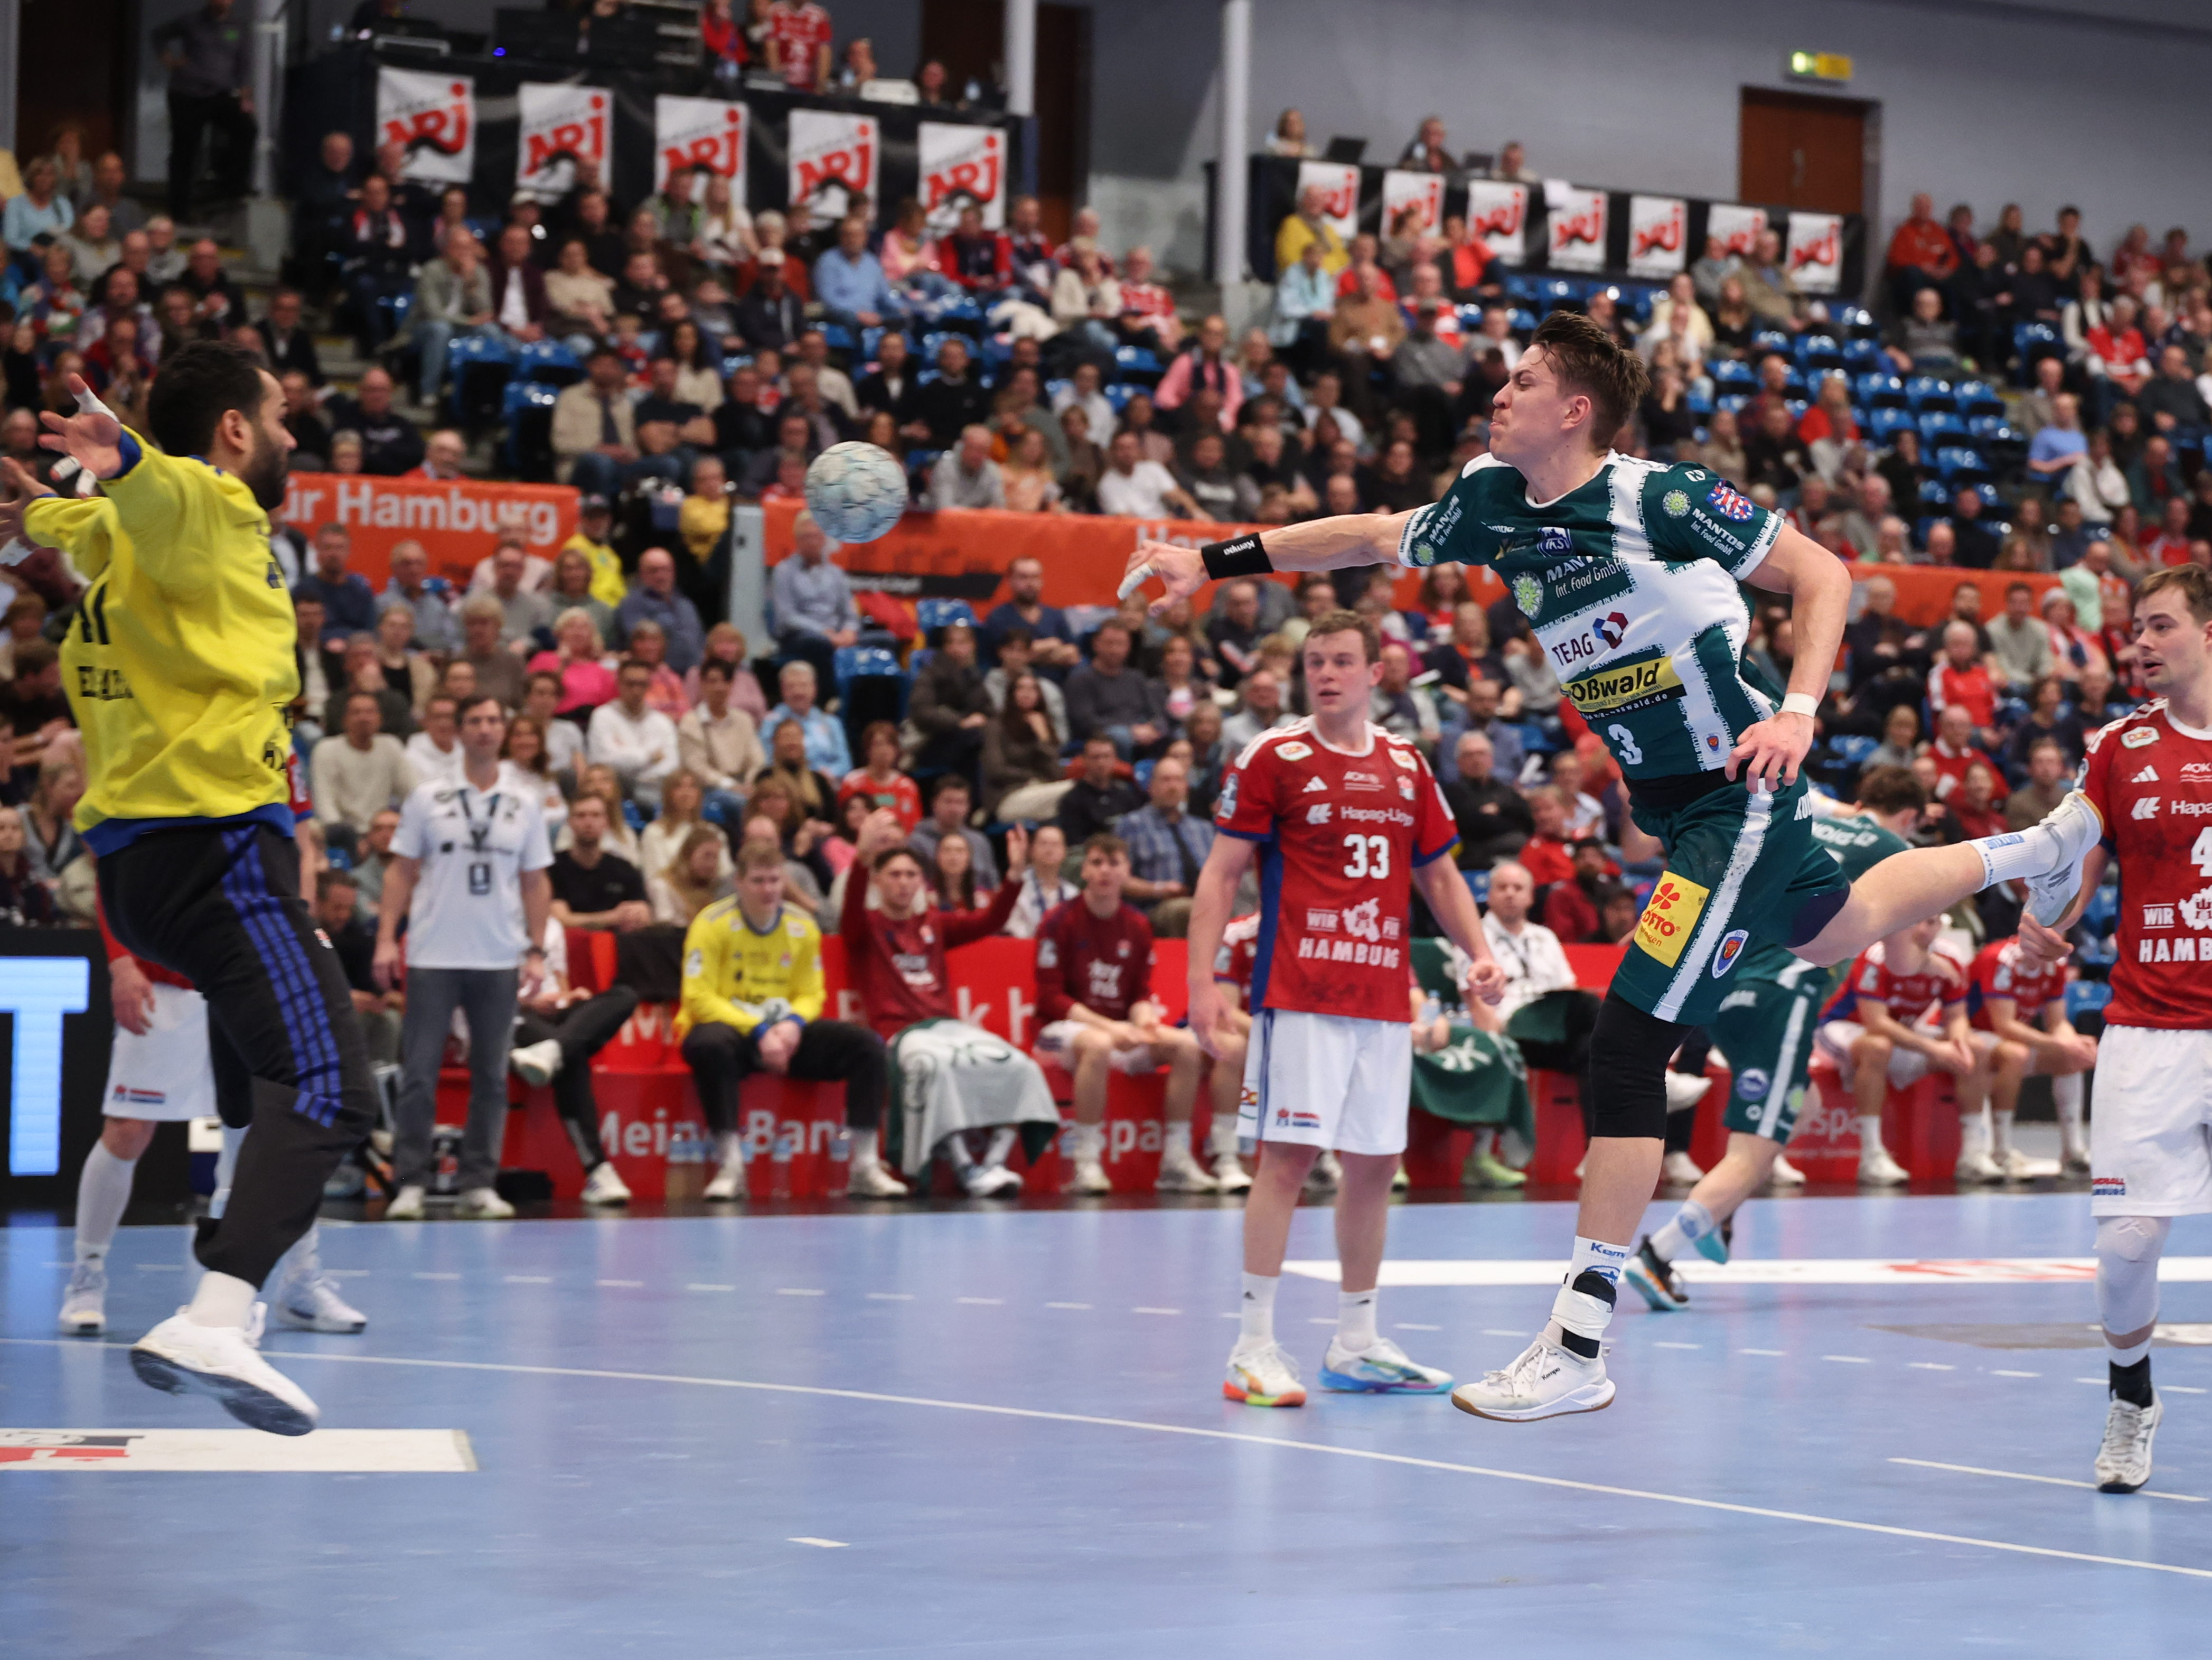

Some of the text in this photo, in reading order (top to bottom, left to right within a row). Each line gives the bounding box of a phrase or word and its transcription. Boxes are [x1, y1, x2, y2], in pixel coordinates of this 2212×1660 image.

[796, 124, 871, 203] NRJ
[925, 135, 998, 213] NRJ
[336, 481, 557, 546] Hamburg
[1691, 508, 1746, 551] MANTOS
[1690, 520, 1735, 556] Int. Food GmbH
[1555, 584, 1570, 598] Int.
[1571, 570, 1592, 591] Food
[1593, 557, 1625, 581] GmbH
[1552, 633, 1594, 666] TEAG
[1607, 724, 1643, 766] 3
[1343, 834, 1390, 880] 33
[2190, 826, 2212, 877] 4
[1641, 909, 1675, 937] OTTO
[2143, 907, 2174, 926] WIR
[1541, 1366, 1561, 1381] Kempa
